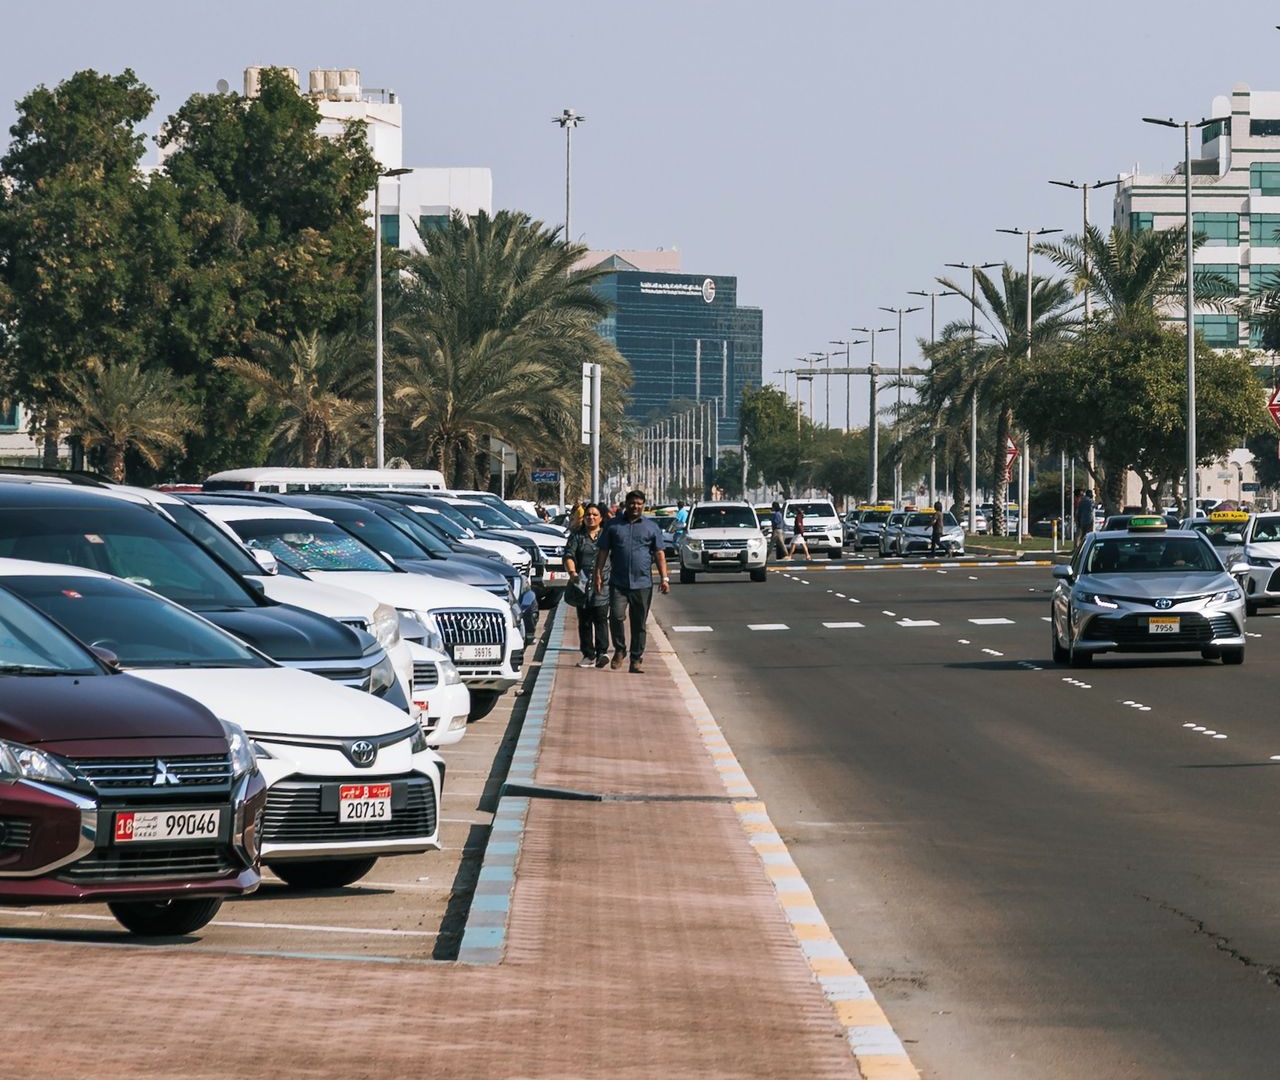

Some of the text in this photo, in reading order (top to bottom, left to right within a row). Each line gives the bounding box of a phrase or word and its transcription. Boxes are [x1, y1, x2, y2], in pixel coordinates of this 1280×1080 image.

[1154, 624, 1174, 632] 7956
[363, 786, 369, 798] 8
[346, 801, 385, 819] 20713
[117, 818, 133, 835] 18
[166, 812, 216, 836] 99046
